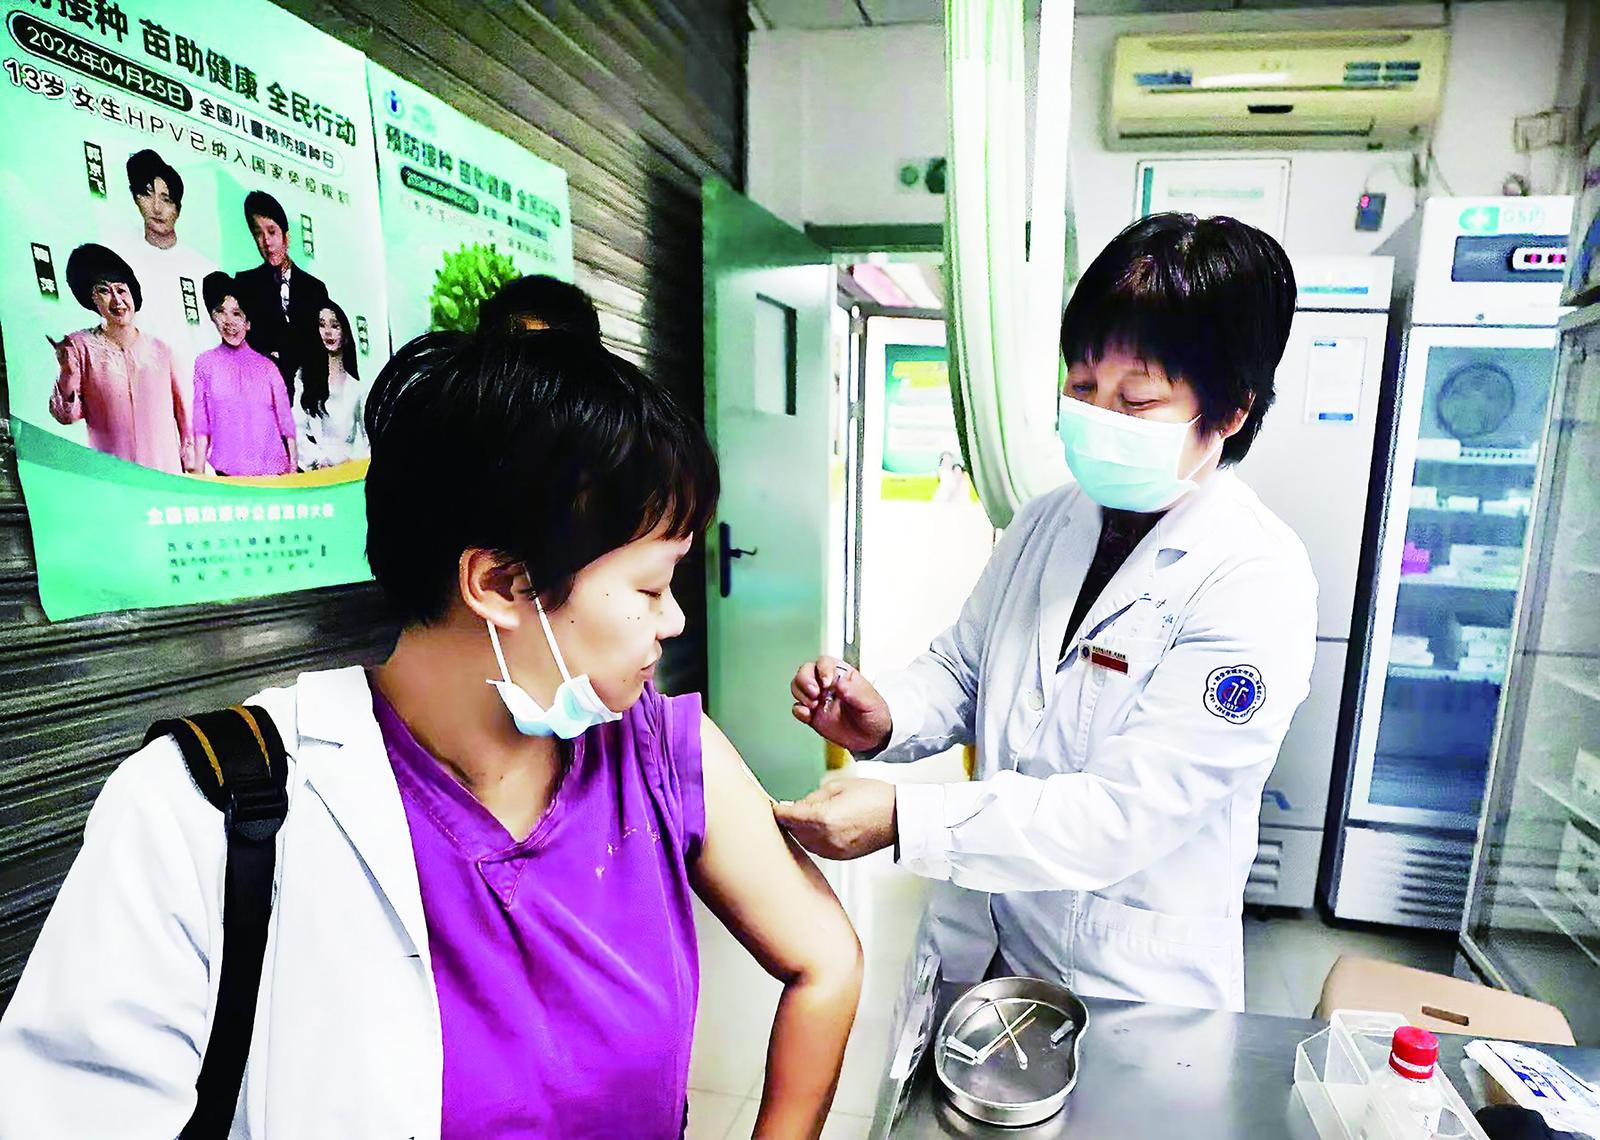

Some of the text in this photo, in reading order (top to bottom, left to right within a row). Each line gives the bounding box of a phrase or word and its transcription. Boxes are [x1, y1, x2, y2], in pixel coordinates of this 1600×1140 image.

[26, 26, 185, 106] 2026年04月25日
[138, 18, 259, 103] 苗助健康
[267, 82, 356, 146] 全民行动
